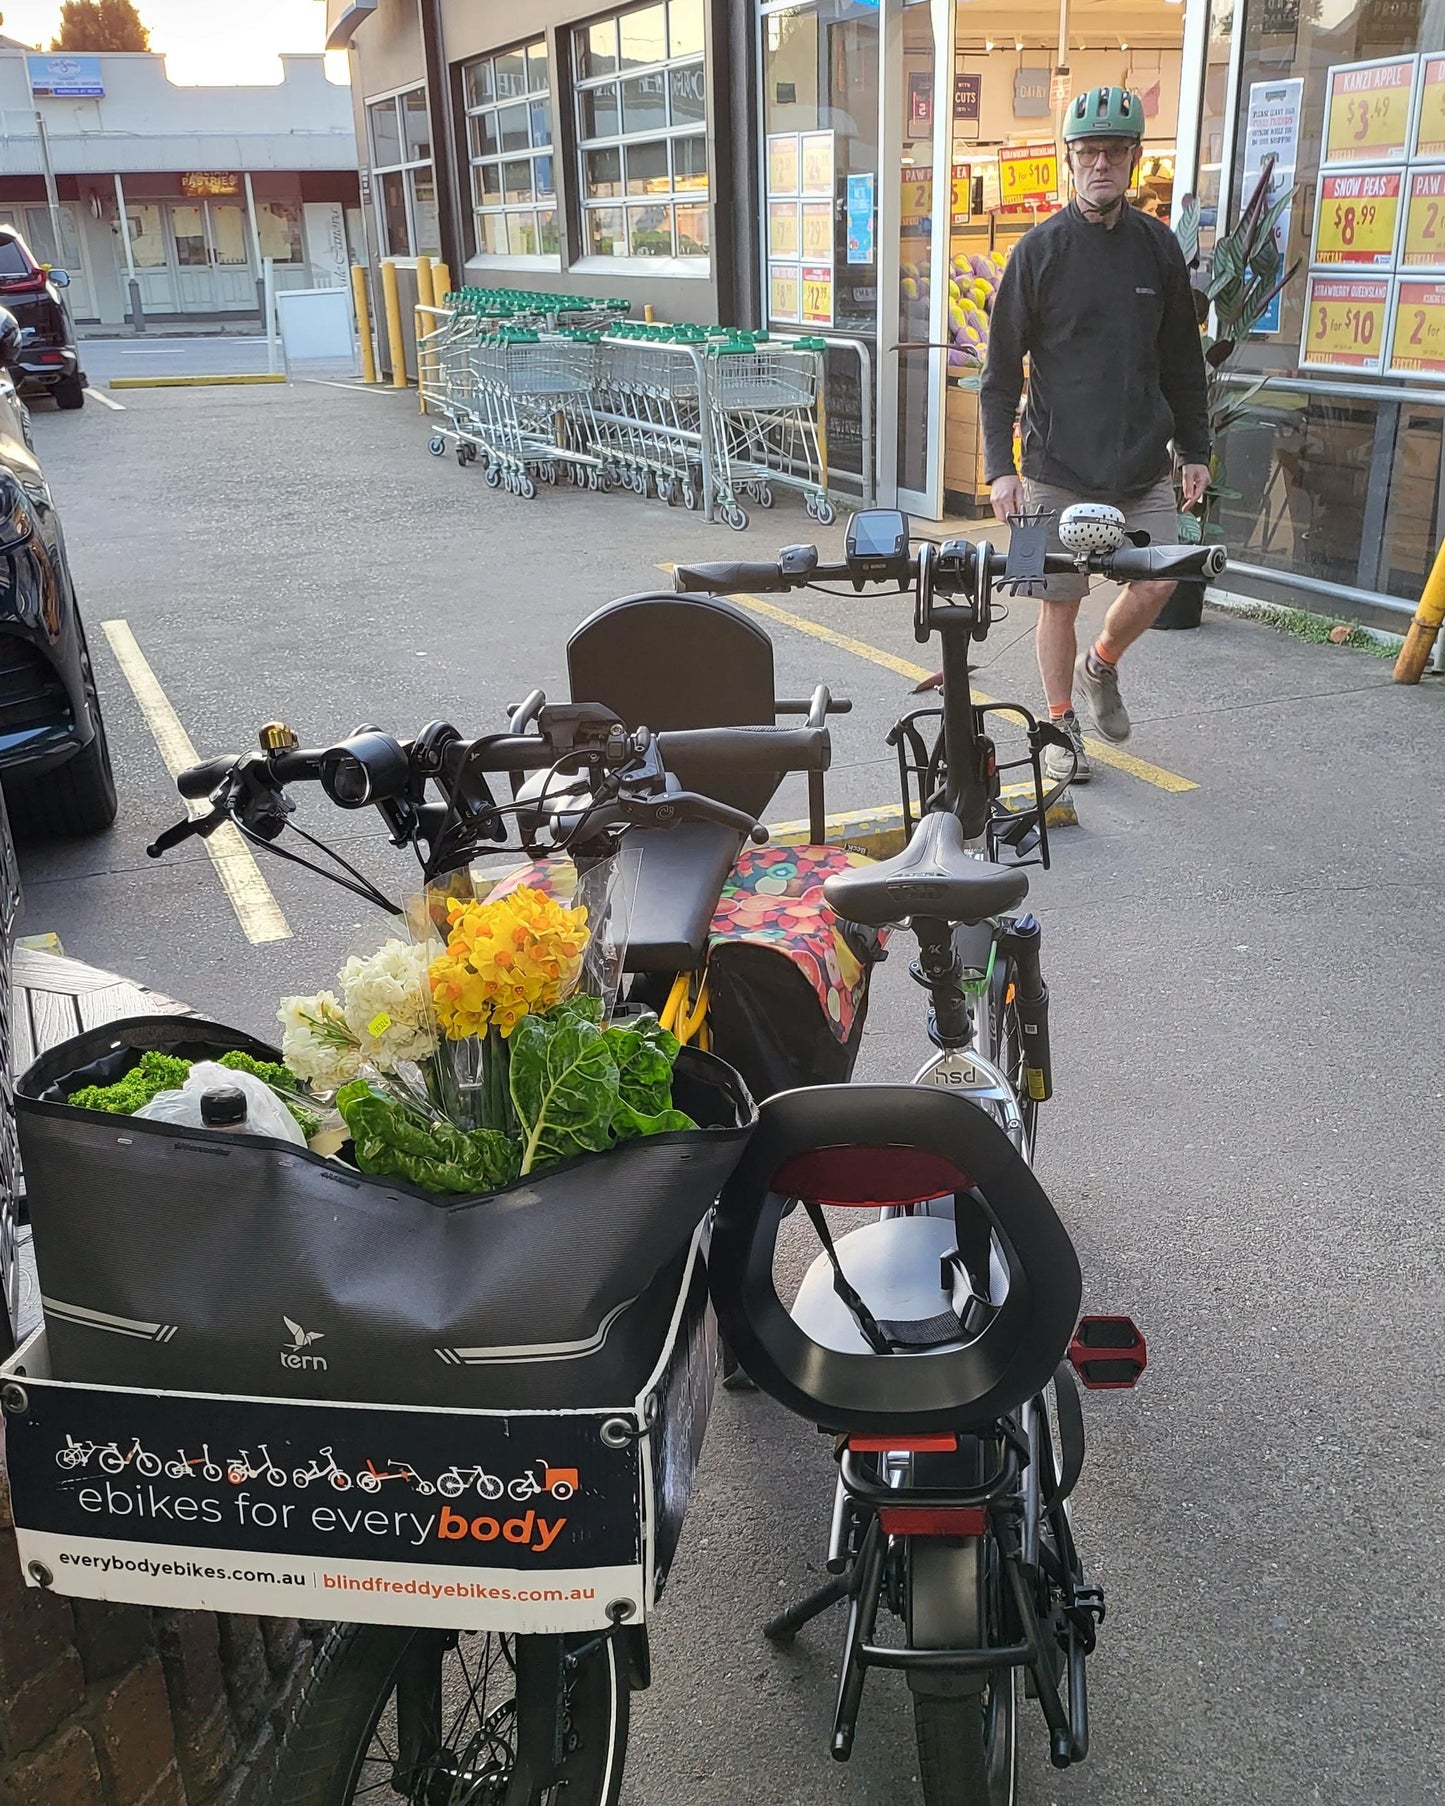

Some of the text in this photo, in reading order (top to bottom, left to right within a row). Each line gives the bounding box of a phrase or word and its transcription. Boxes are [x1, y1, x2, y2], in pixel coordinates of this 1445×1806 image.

[1344, 67, 1403, 91] KANZI APPLE
[954, 91, 977, 103] CUTS
[1346, 96, 1391, 141] $3.49
[181, 175, 237, 187] PASTRIES
[905, 169, 925, 182] PAW
[1007, 166, 1016, 187] 3
[1029, 164, 1050, 185] $10
[1334, 175, 1387, 197] SNOW PEAS
[1416, 175, 1440, 195] PAW
[914, 185, 926, 207] 2
[1334, 203, 1376, 246] $8.99
[1422, 202, 1439, 239] 2
[1313, 284, 1387, 299] STRAWBERRY QUEENSLAND
[1315, 306, 1374, 344] 3 for $10
[1409, 310, 1441, 345] 2 for
[935, 1067, 976, 1084] hsd
[280, 1351, 328, 1371] tern
[79, 1481, 567, 1552] ebikes for everybody
[58, 1551, 596, 1602] everybodyebikes.com.au blindfreddyebikes.com.au
